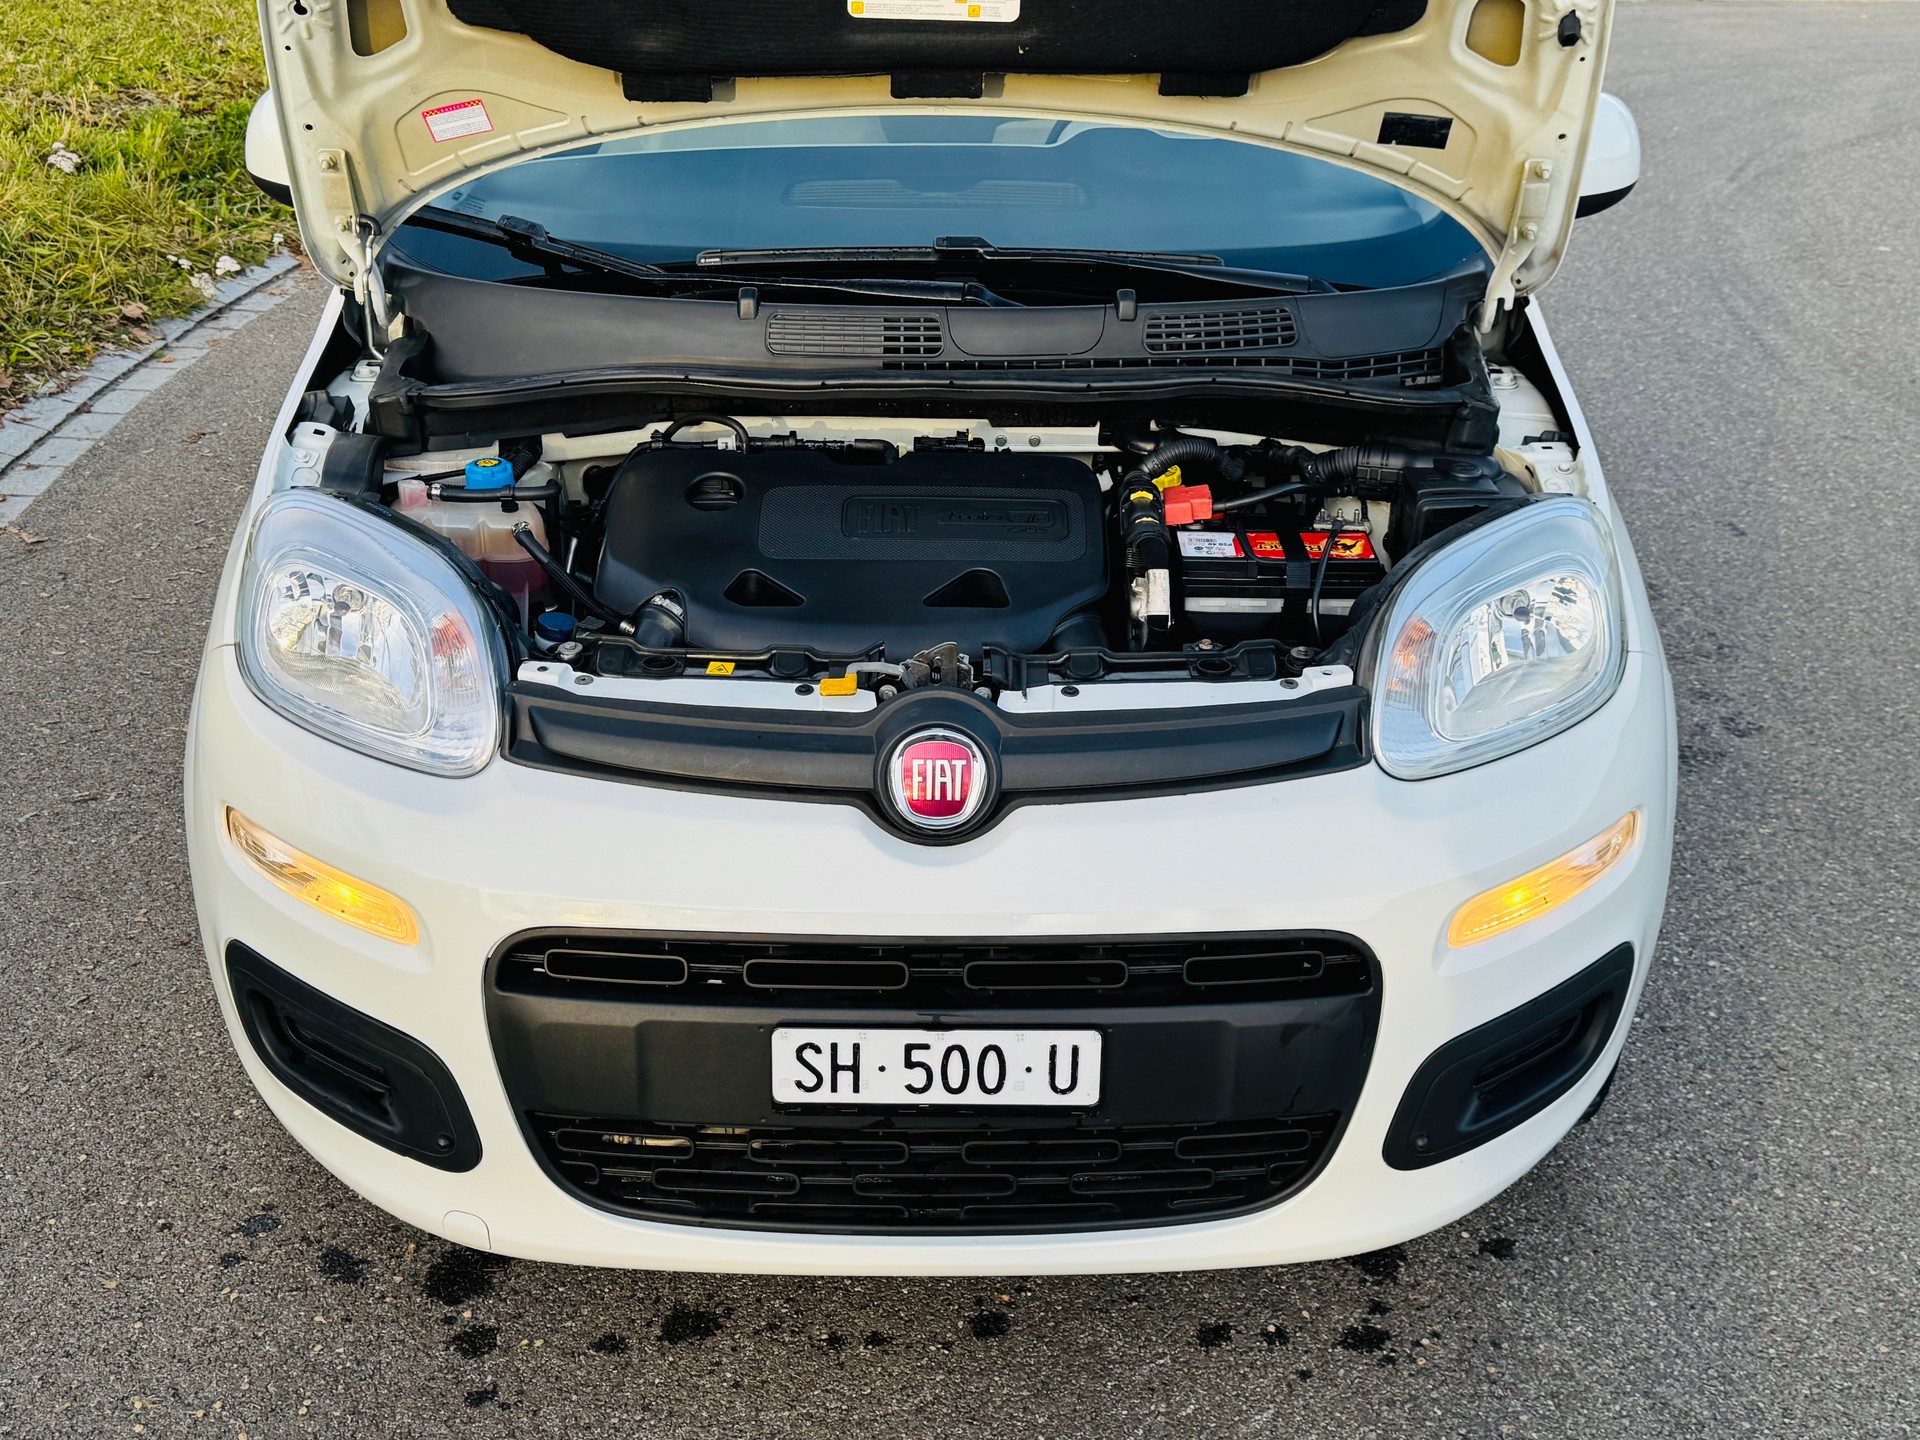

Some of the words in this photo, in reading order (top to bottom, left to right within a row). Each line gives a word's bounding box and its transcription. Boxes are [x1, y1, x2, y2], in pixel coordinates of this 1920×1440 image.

[857, 504, 924, 534] FIAT
[912, 758, 967, 802] FIAT
[794, 1042, 861, 1094] SH
[904, 1043, 1007, 1095] 500
[1049, 1044, 1079, 1095] U
